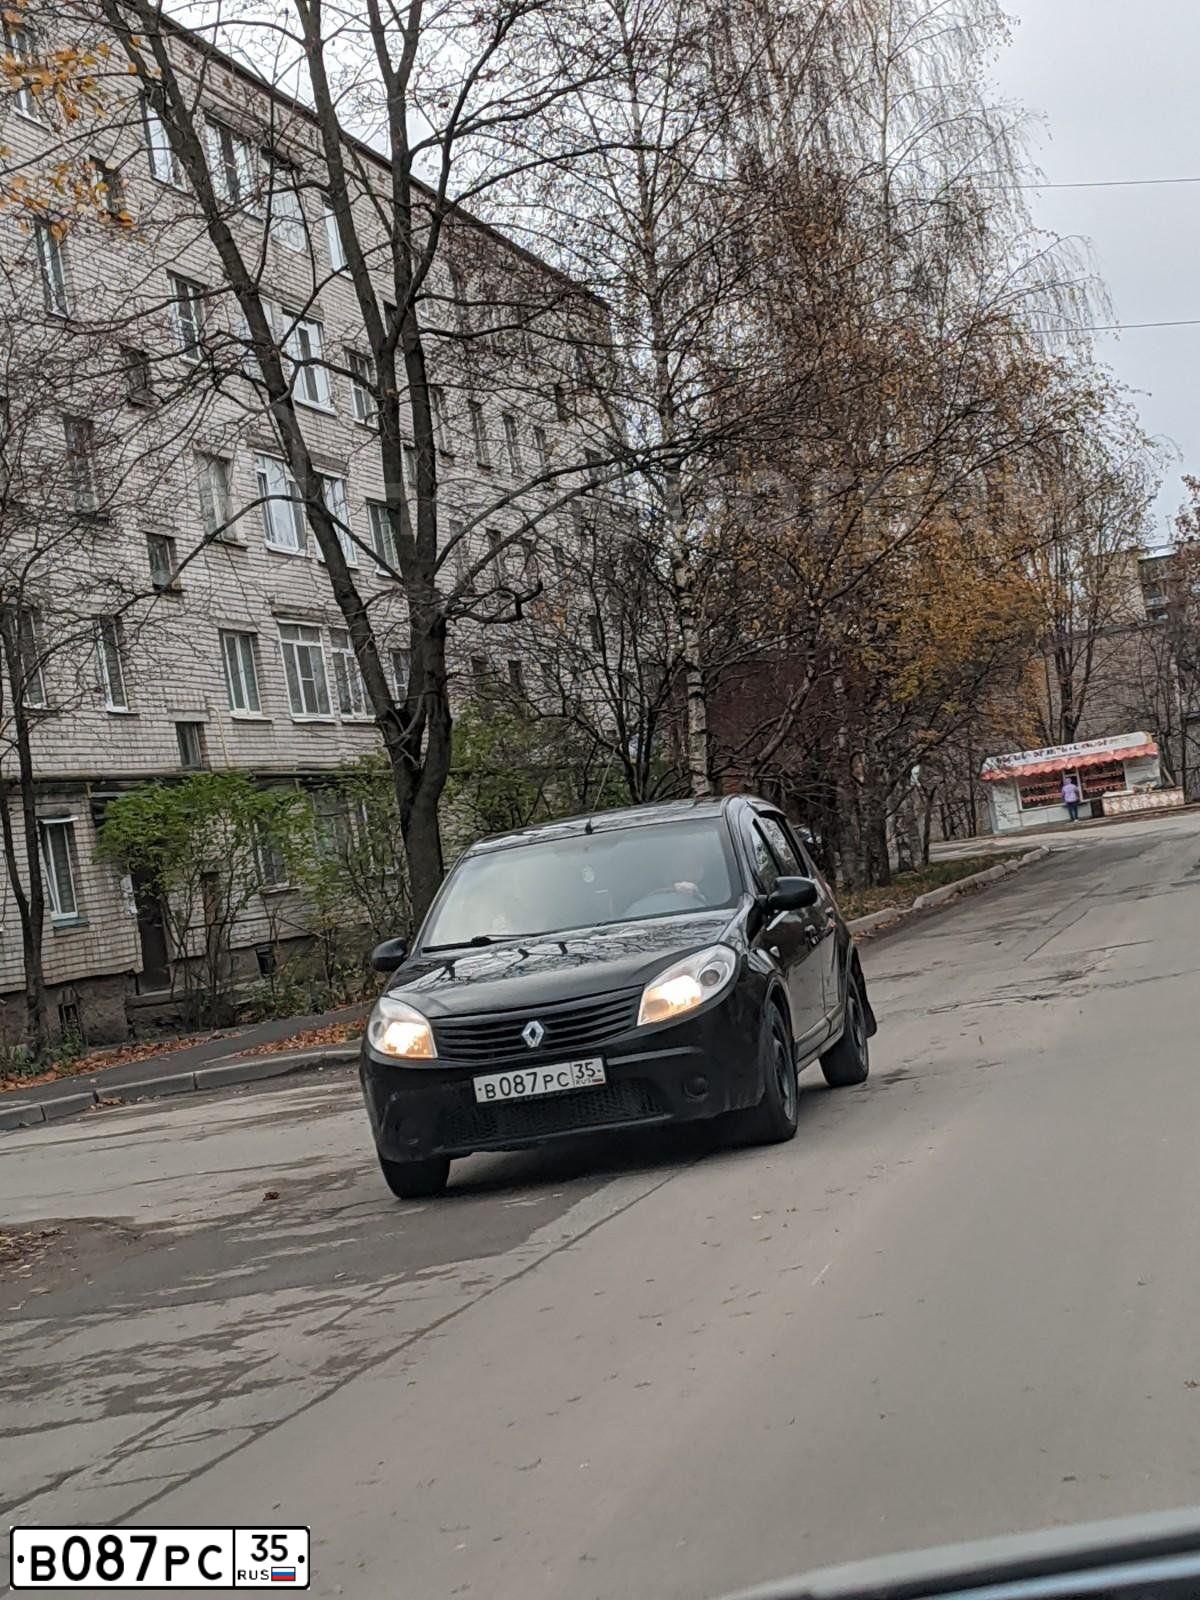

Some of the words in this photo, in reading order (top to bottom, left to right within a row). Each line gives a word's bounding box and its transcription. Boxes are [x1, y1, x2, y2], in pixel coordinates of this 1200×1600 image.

[484, 1071, 570, 1099] В087РС
[574, 1062, 596, 1079] 35
[575, 1078, 592, 1086] RUS
